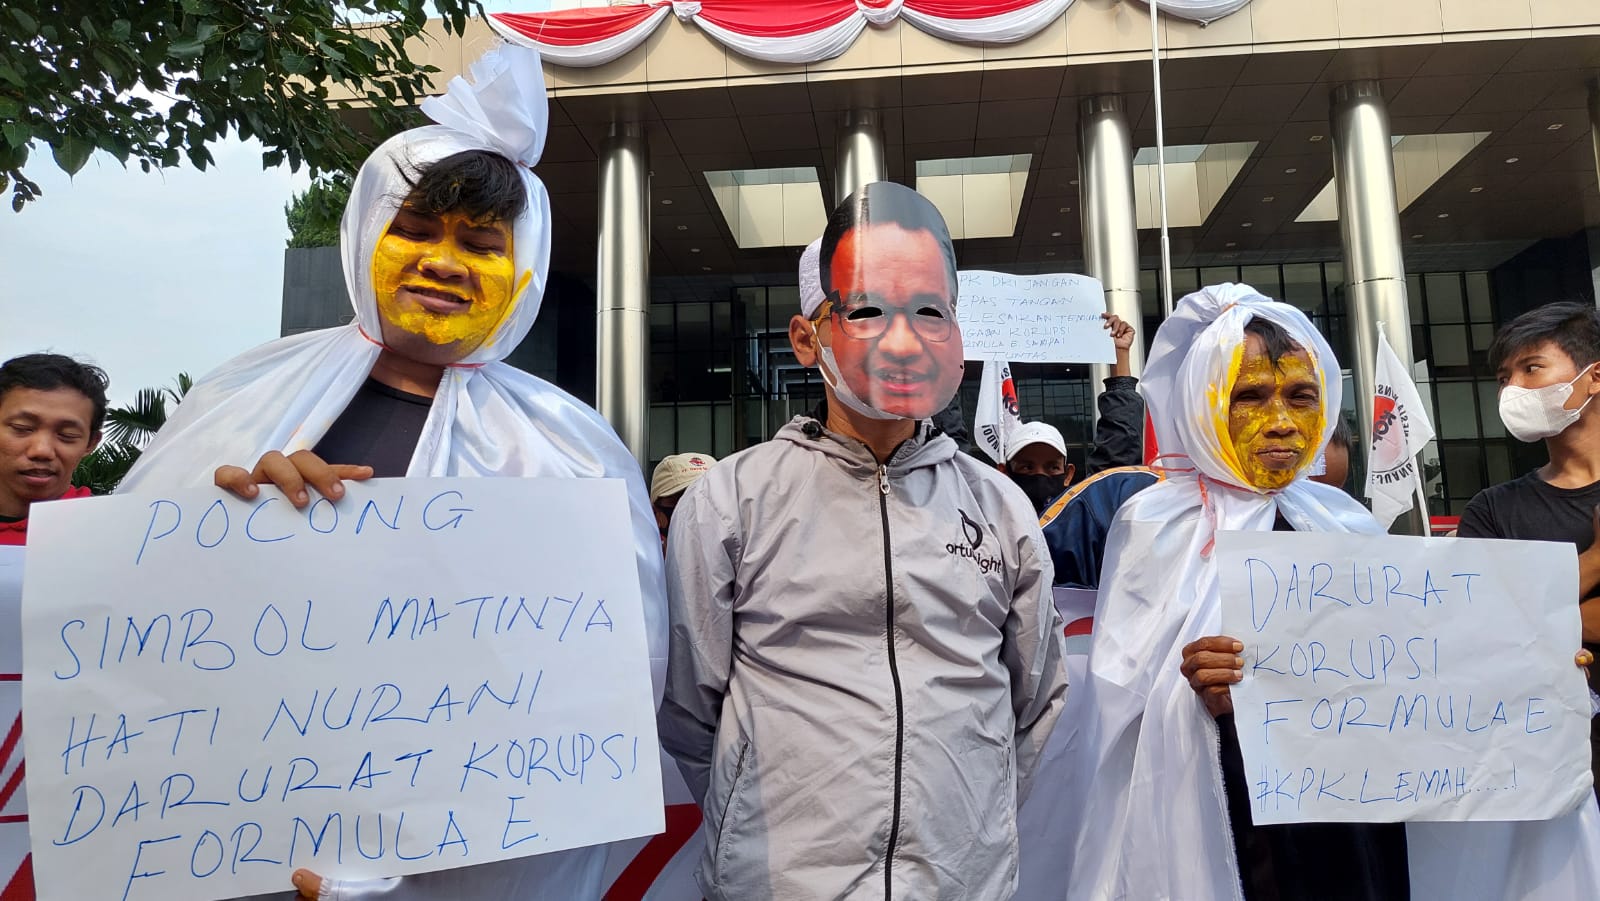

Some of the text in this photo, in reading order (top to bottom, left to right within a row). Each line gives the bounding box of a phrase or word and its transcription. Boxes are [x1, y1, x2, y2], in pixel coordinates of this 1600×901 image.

[958, 295, 1074, 309] EPAS TANGAN
[959, 274, 981, 287] PK
[1024, 278, 1080, 291] JANGAN
[957, 312, 1052, 325] ELESAIKAN
[1009, 326, 1070, 338] KORUPSI
[136, 489, 474, 565] POCONG
[1244, 558, 1481, 632] DARURAT
[54, 591, 615, 680] SIMBOL MATINYA
[1252, 634, 1438, 684] KORUPSI
[62, 669, 543, 775] HATI NURANI
[1263, 693, 1552, 744] FORMULA E
[53, 732, 638, 846] DARURAT KORUPSI
[122, 810, 469, 901] FORMULA
